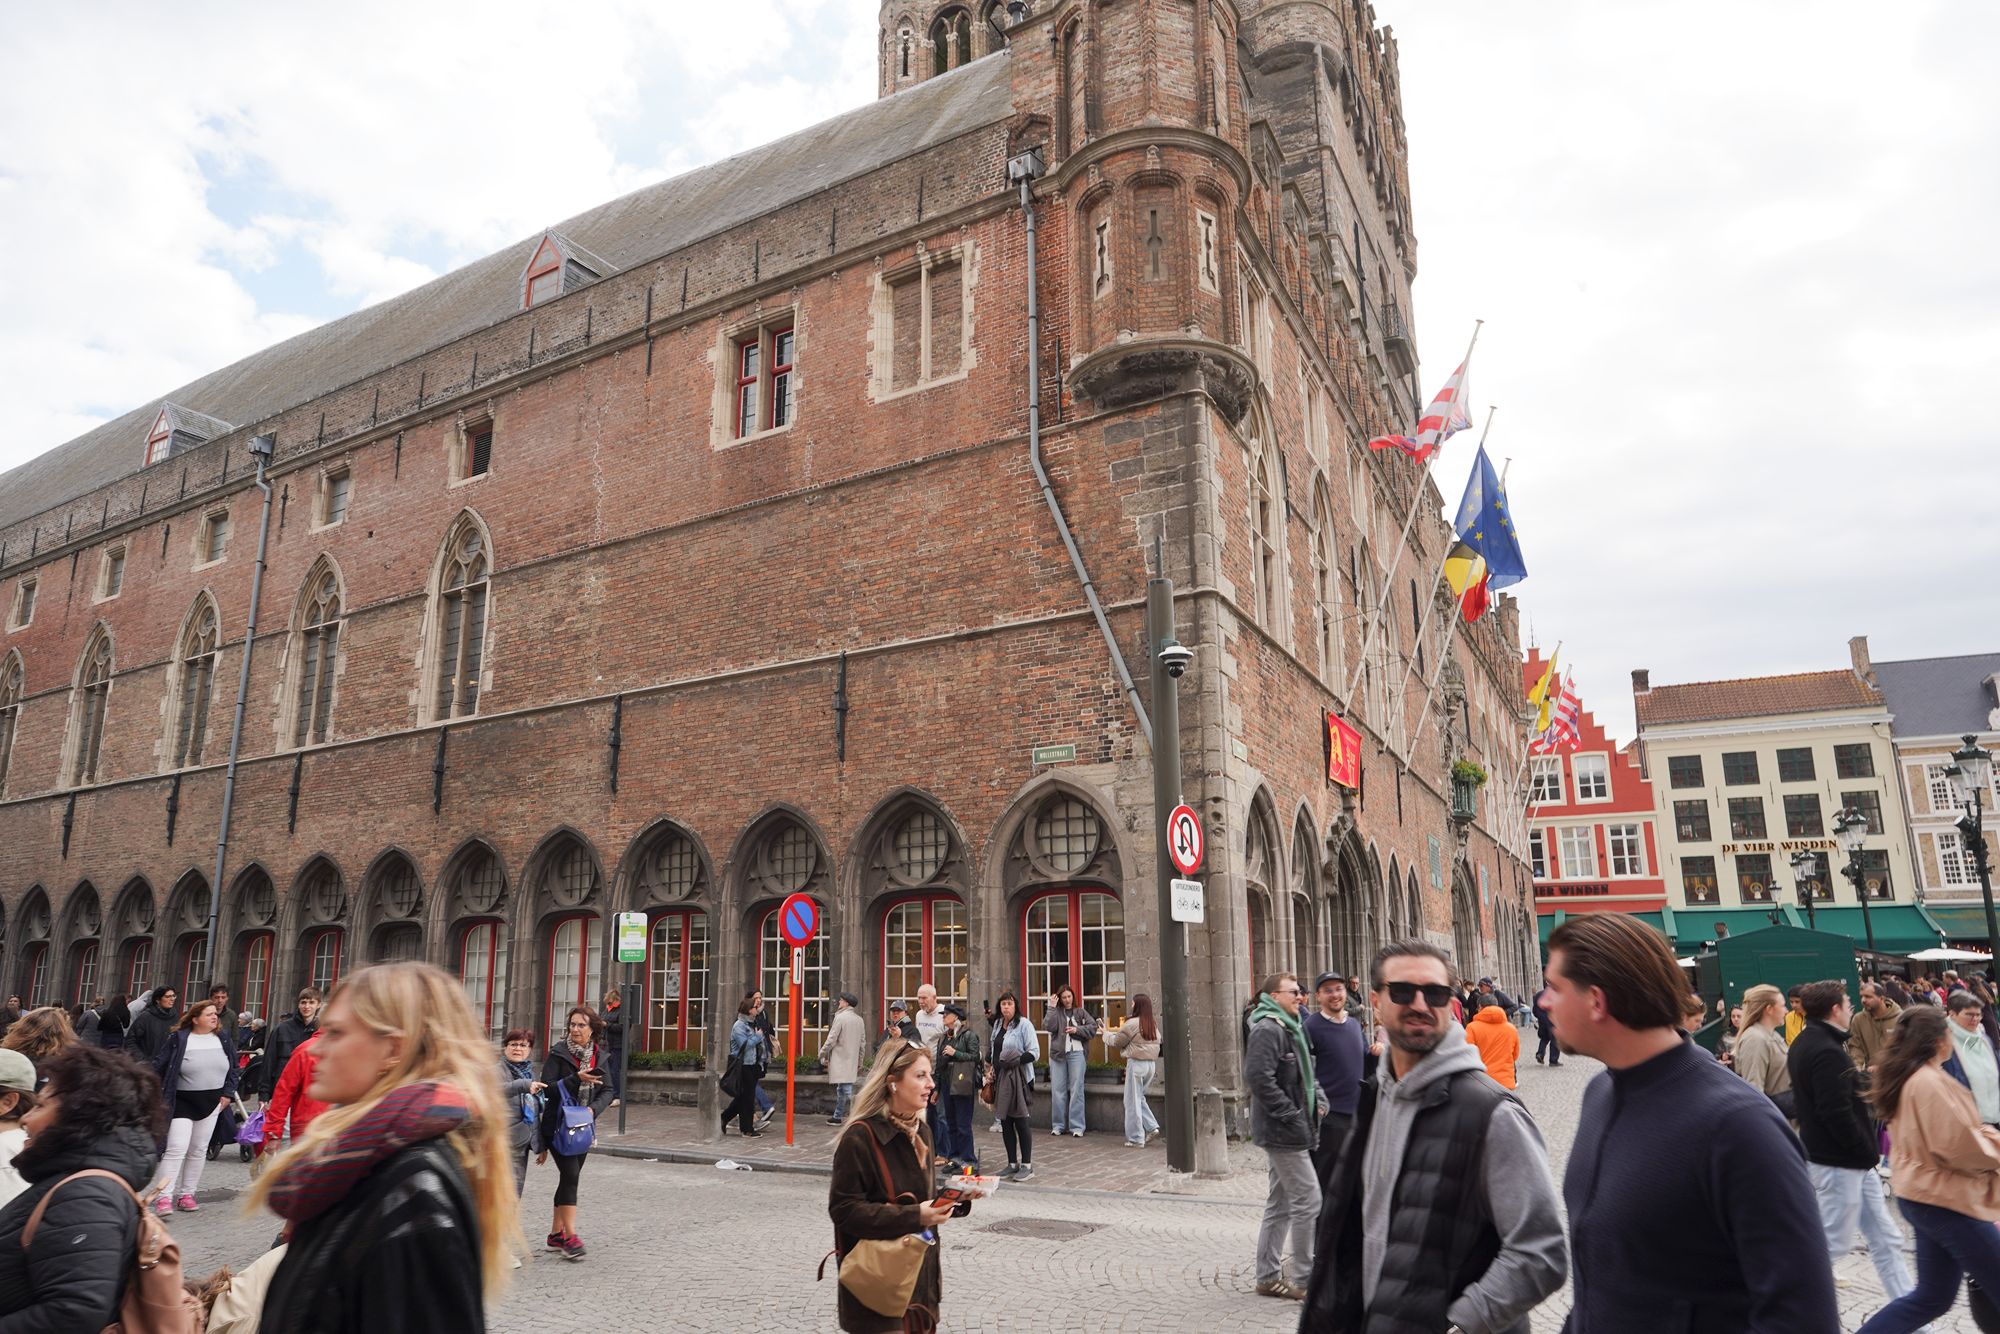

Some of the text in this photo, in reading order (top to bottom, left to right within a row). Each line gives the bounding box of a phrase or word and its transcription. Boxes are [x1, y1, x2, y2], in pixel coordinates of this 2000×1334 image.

[1721, 839, 1837, 853] DE VIER WINDEN
[1534, 883, 1609, 896] IER WINDEN
